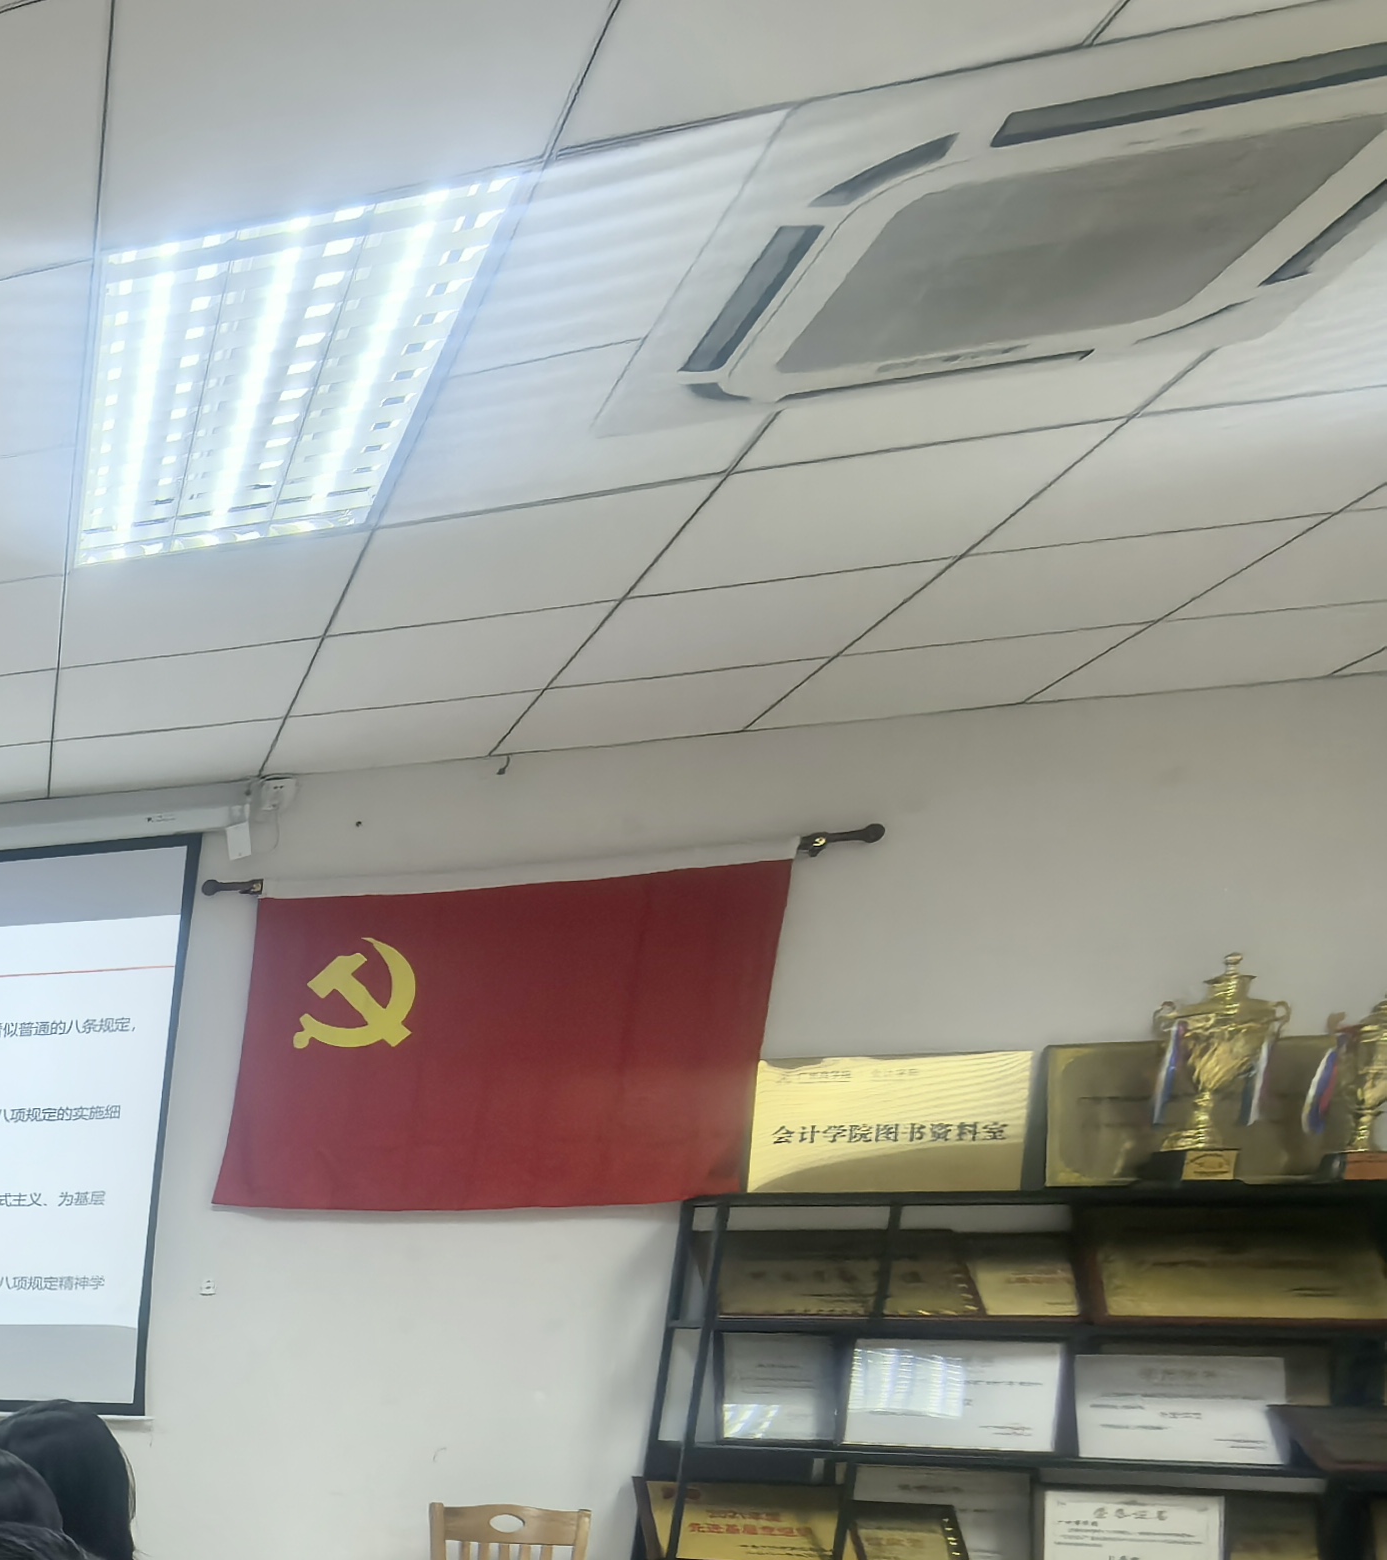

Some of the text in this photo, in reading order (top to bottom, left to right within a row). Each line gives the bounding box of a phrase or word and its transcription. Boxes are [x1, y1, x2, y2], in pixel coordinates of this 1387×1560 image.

[772, 1121, 1010, 1145] 会计学院图书资料室
